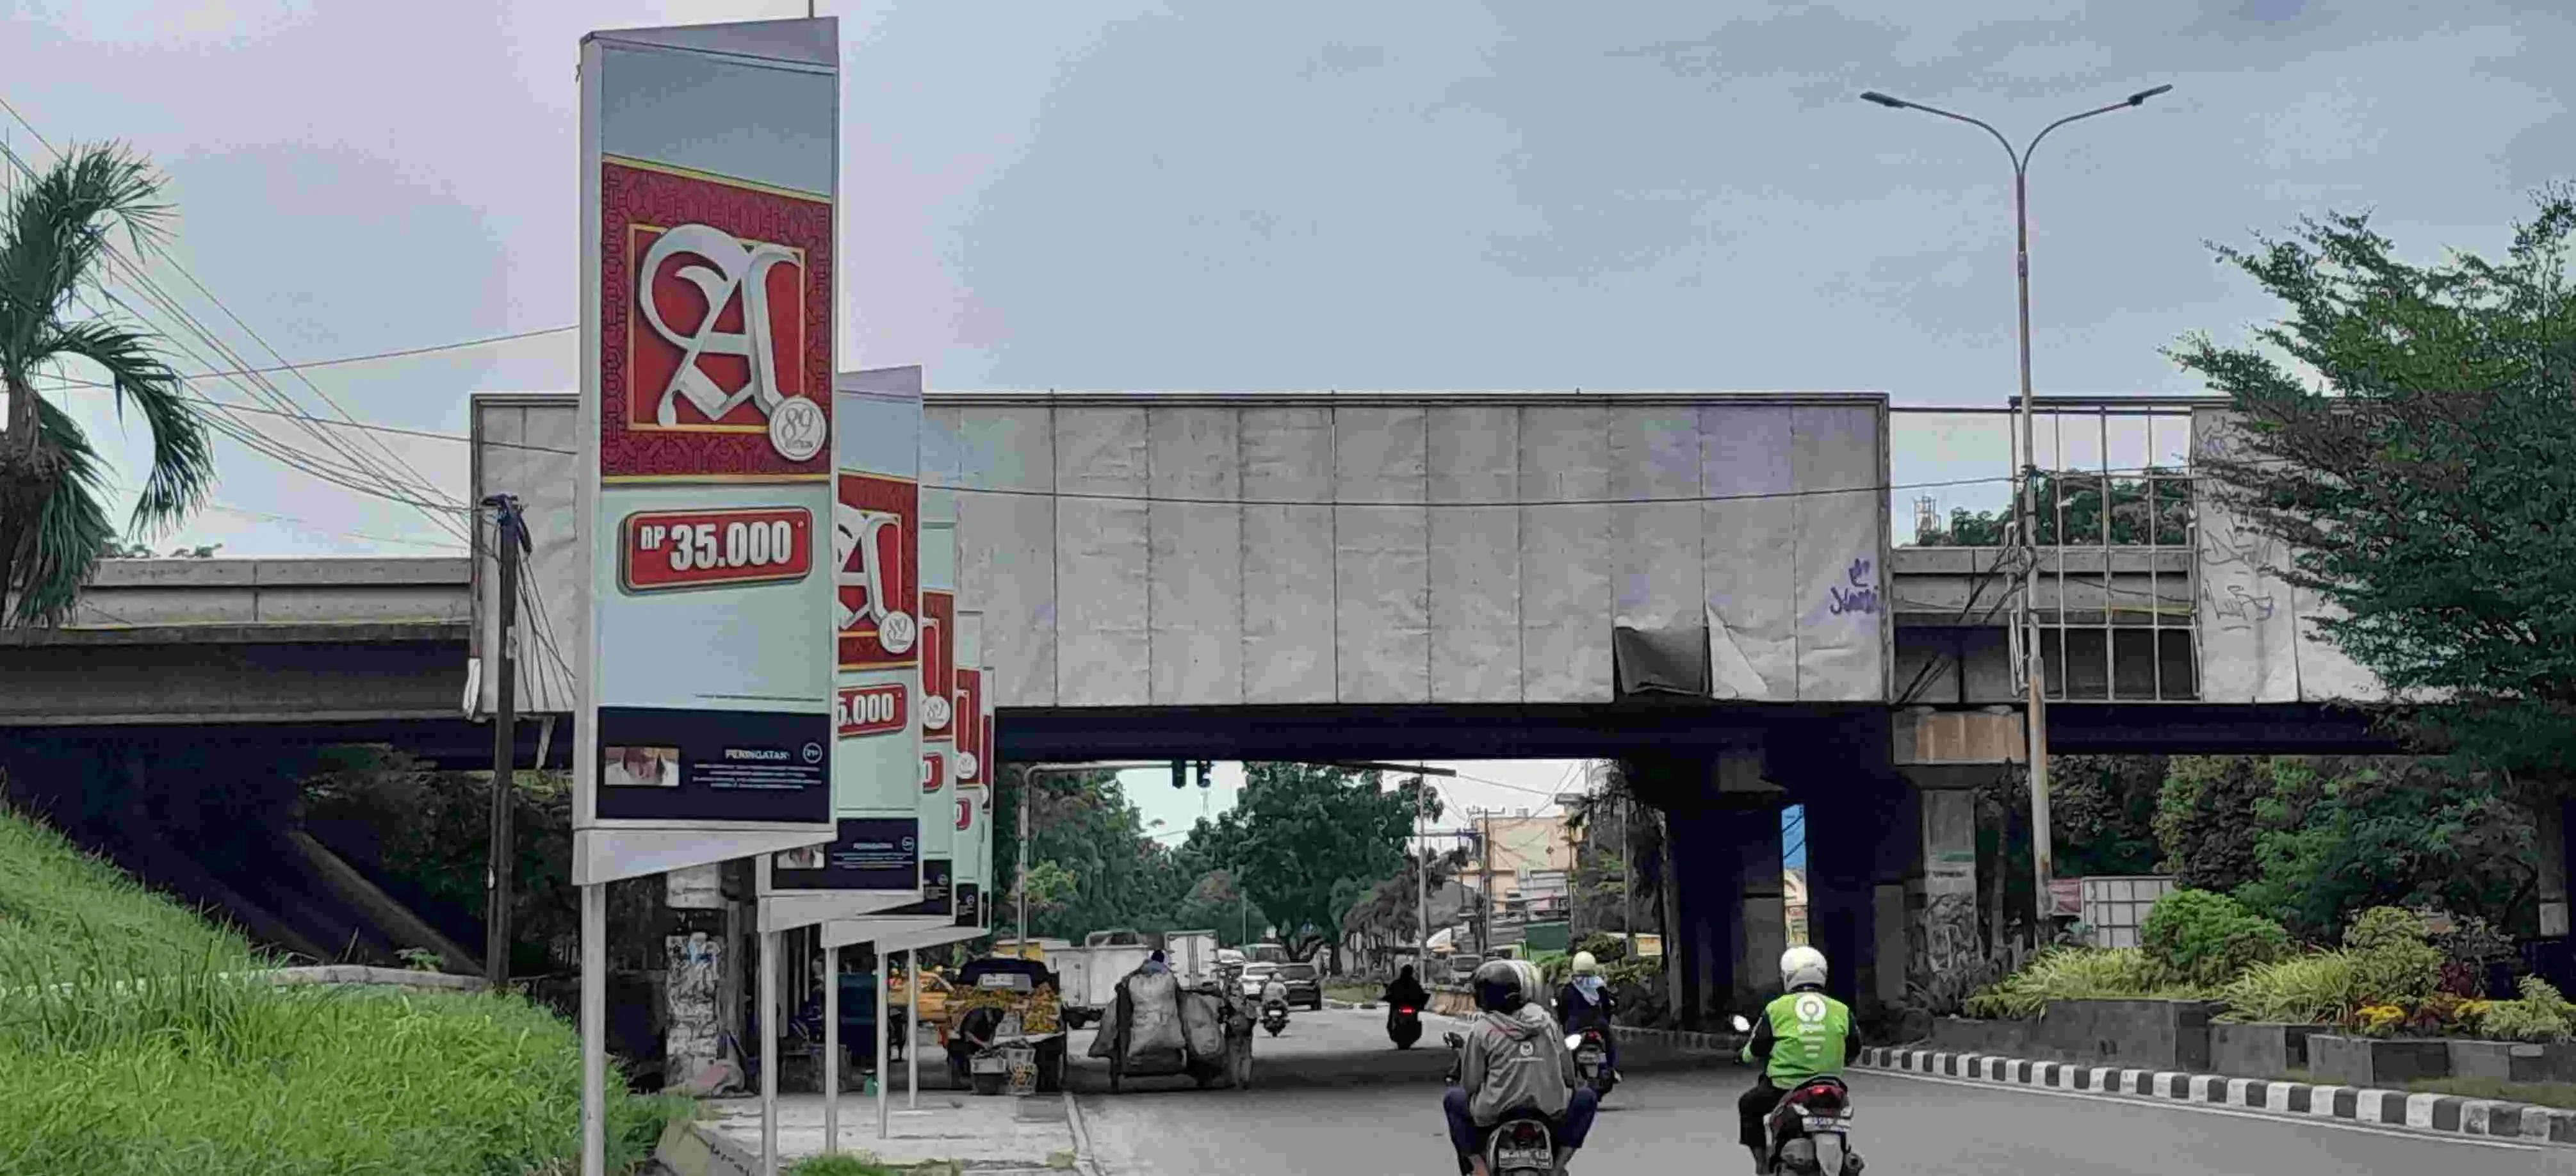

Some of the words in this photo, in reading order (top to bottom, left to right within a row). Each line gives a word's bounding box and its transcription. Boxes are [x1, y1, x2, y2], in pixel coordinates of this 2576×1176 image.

[639, 223, 801, 428] A
[781, 407, 813, 441] 89
[837, 692, 895, 727] 5.000
